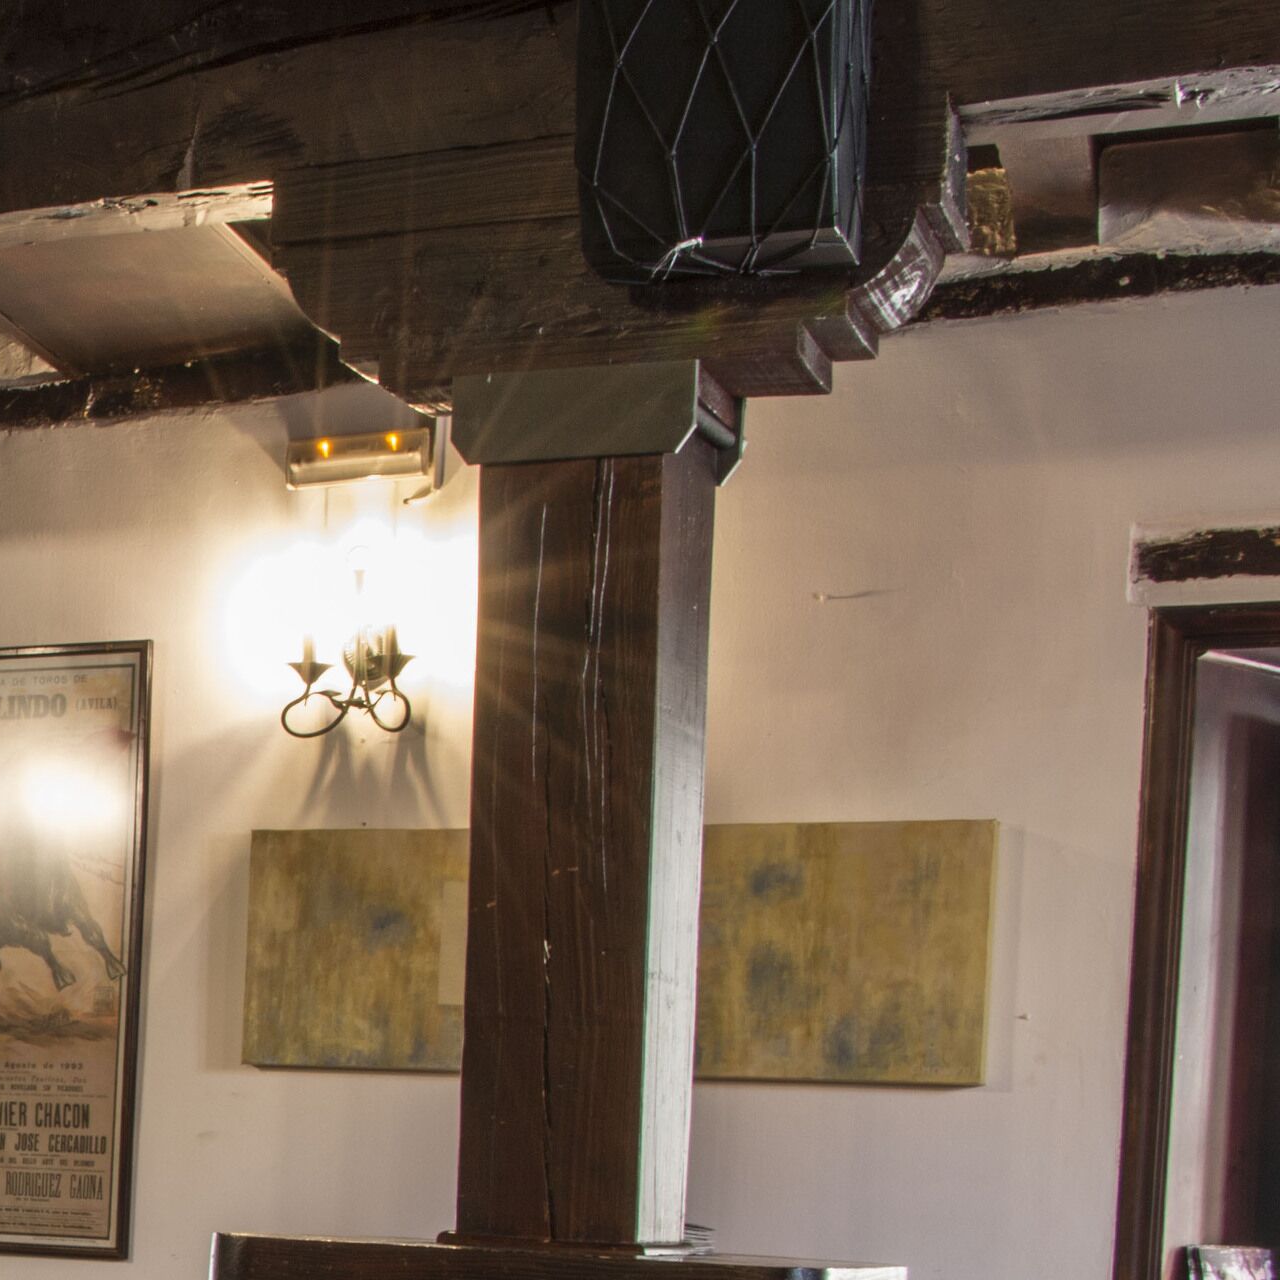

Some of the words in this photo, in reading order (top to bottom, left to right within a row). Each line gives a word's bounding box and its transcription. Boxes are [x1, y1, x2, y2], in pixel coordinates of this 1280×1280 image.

[33, 675, 67, 685] TOROS
[73, 674, 88, 683] DE
[35, 1103, 90, 1129] CHACON
[15, 1133, 39, 1152] JOSE
[48, 1134, 107, 1155] CERCADILLO
[5, 1171, 62, 1199] RODRIGUEZ
[70, 1174, 104, 1201] GAONA
